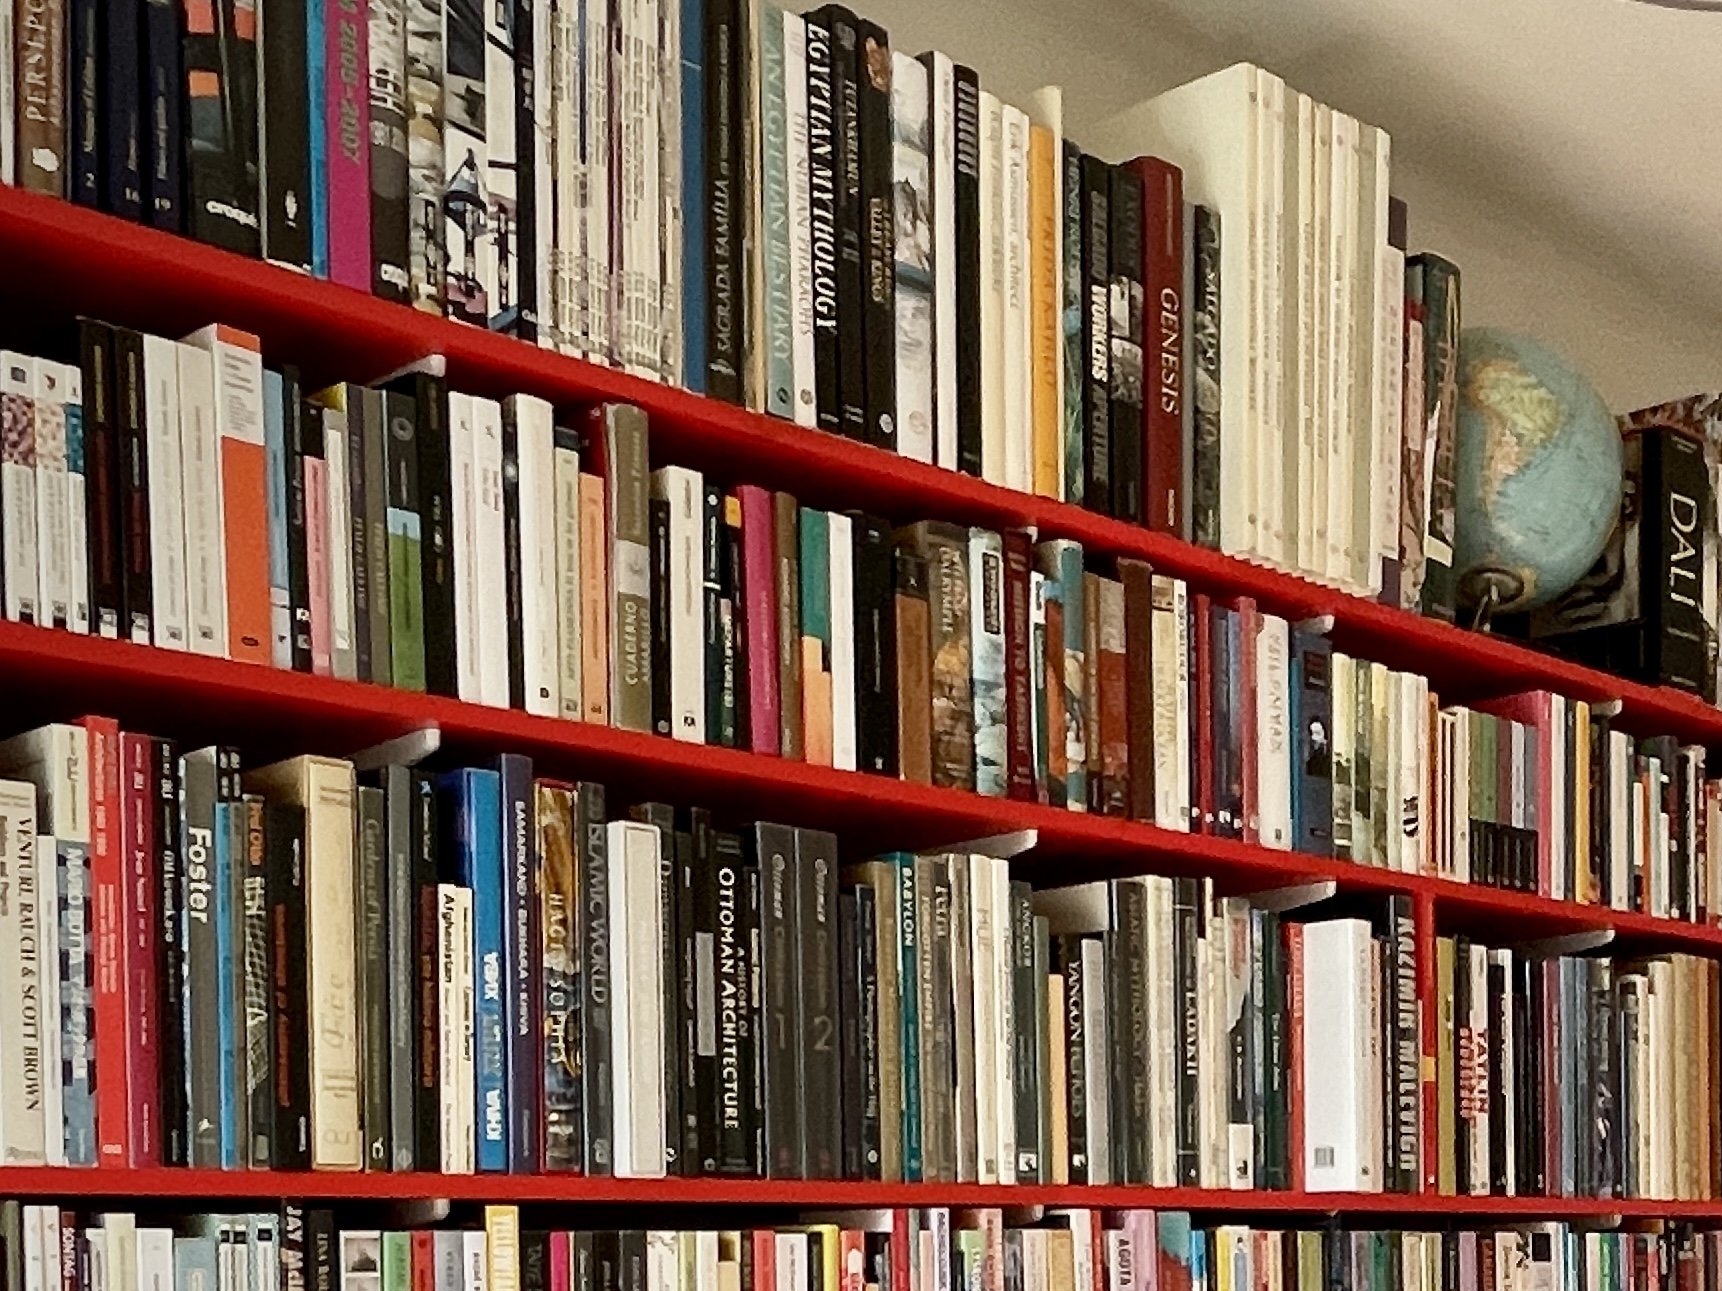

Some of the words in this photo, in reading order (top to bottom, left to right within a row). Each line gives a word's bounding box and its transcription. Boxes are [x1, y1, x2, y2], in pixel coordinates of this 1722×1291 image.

[808, 23, 833, 158] EGYPTIAN
[811, 163, 837, 335] MYTHOLOGY
[712, 263, 732, 353] SAGRADA
[1091, 284, 1109, 384] WORKERS
[1160, 286, 1181, 418] GENESIS
[1669, 491, 1698, 607] DALI
[623, 601, 639, 685] CUADERNO
[189, 826, 213, 924] Foster
[587, 822, 608, 915] ISLAMIC
[902, 866, 914, 947] BABYLON
[19, 902, 37, 961] RAUCH
[590, 919, 609, 1003] WORLD
[718, 866, 736, 975] OTTOMAN
[22, 983, 39, 1042] SCOTT
[23, 966, 36, 979] &
[1068, 960, 1083, 1042] YANGON
[1397, 916, 1416, 1030] KAZIMIR
[721, 979, 742, 1129] ARCHITECTURE
[813, 1015, 834, 1051] 2
[23, 1044, 42, 1112] BROWN
[484, 1089, 502, 1142] KHIVA
[62, 1227, 76, 1278] SONTAG
[286, 1206, 304, 1243] JAY
[1117, 1237, 1133, 1287] AGOTA
